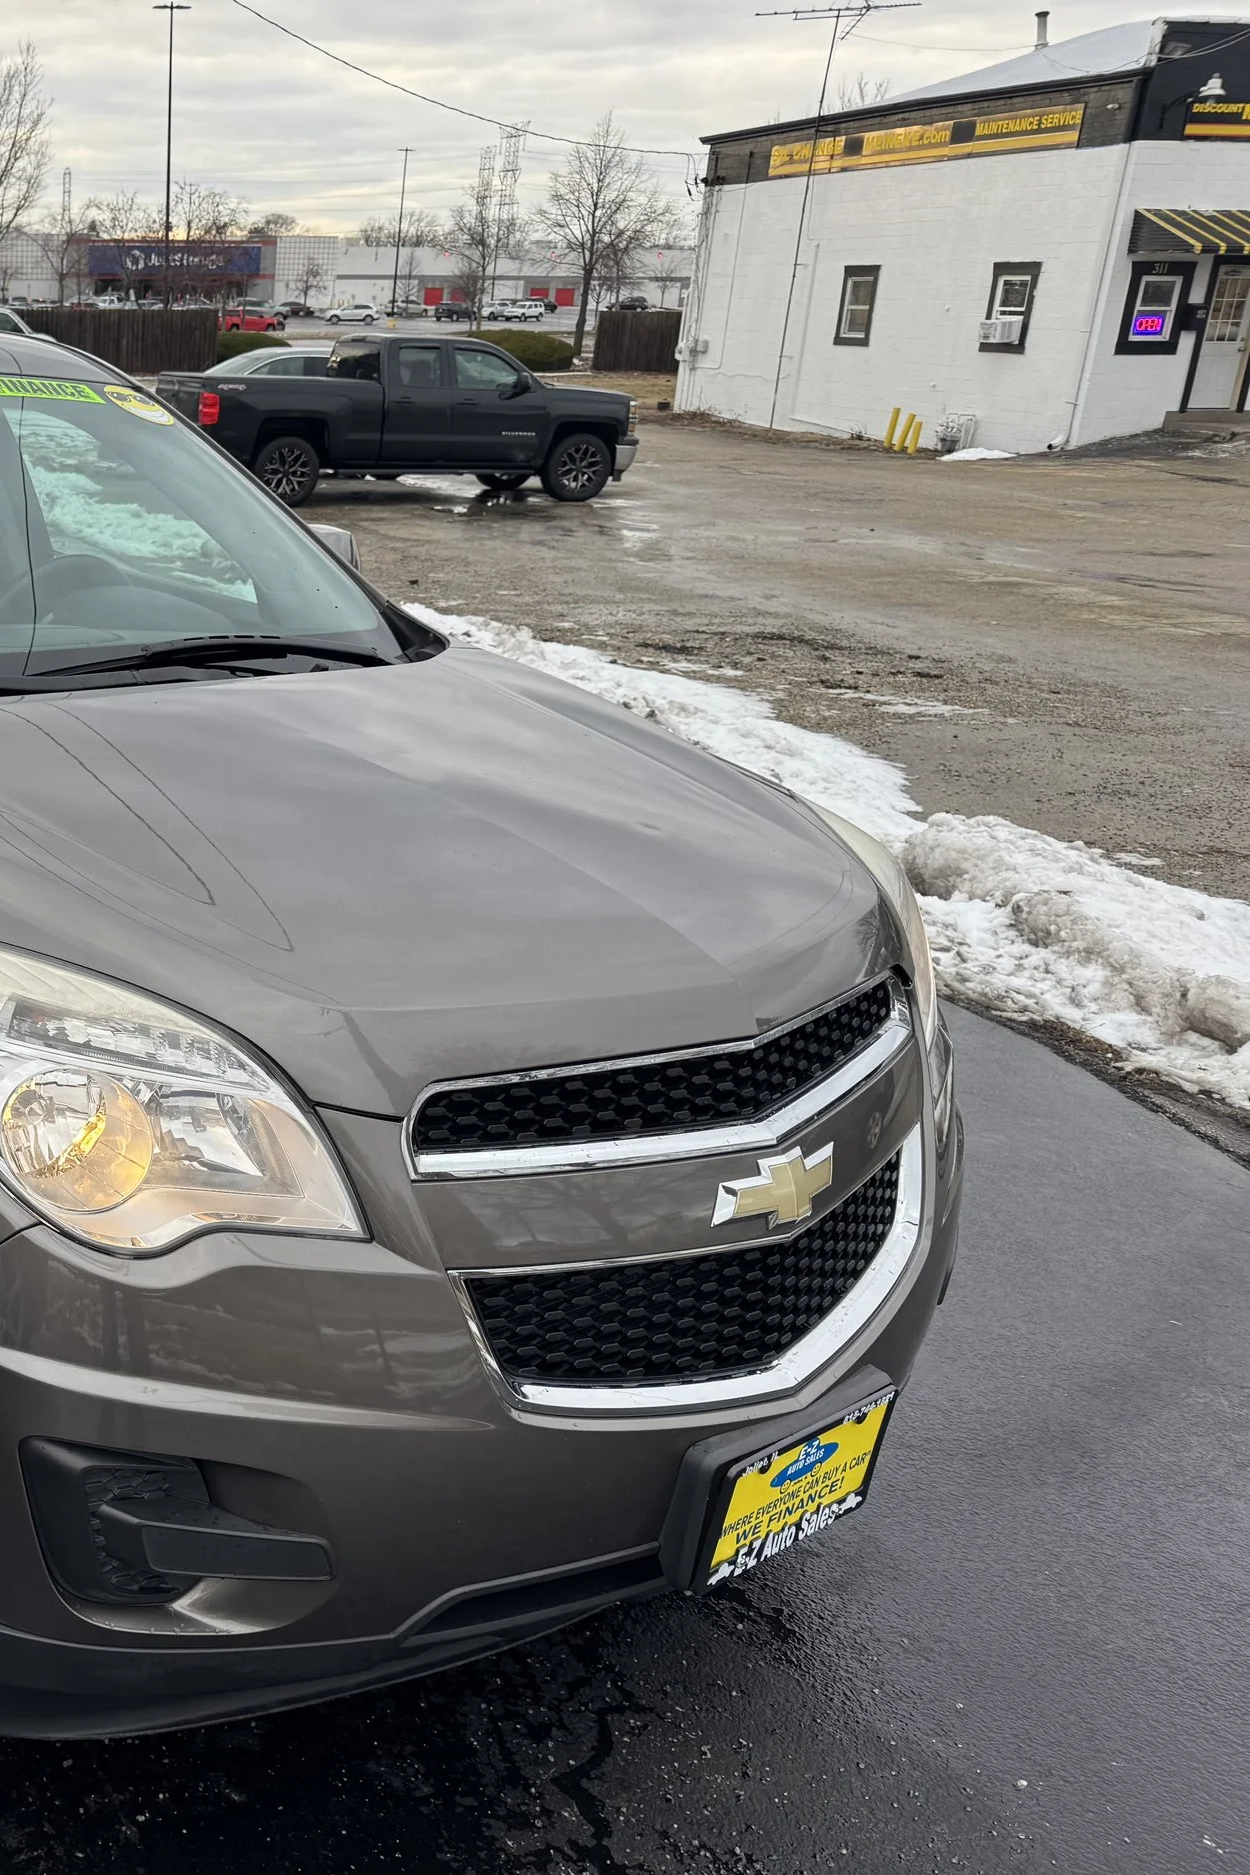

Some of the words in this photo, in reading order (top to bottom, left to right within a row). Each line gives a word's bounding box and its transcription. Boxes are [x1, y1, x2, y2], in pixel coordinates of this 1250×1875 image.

[1192, 103, 1245, 113] DISCOUNT
[975, 119, 1038, 136] MAINTENANCE
[1040, 110, 1083, 129] SERVICE
[1152, 262, 1169, 274] 311
[1136, 318, 1162, 331] OPEN
[787, 1460, 805, 1476] AUTO
[804, 1448, 825, 1466] SALES
[799, 1439, 820, 1460] E-Z
[722, 1512, 754, 1537] WHERE
[755, 1486, 802, 1521] EVERYONE
[803, 1475, 822, 1494] CAN
[822, 1464, 841, 1483] BUY
[840, 1461, 847, 1475] A
[736, 1520, 763, 1544] WE
[767, 1476, 845, 1528] FINANCE!
[760, 1524, 796, 1561] Auto
[798, 1503, 840, 1541] Sales
